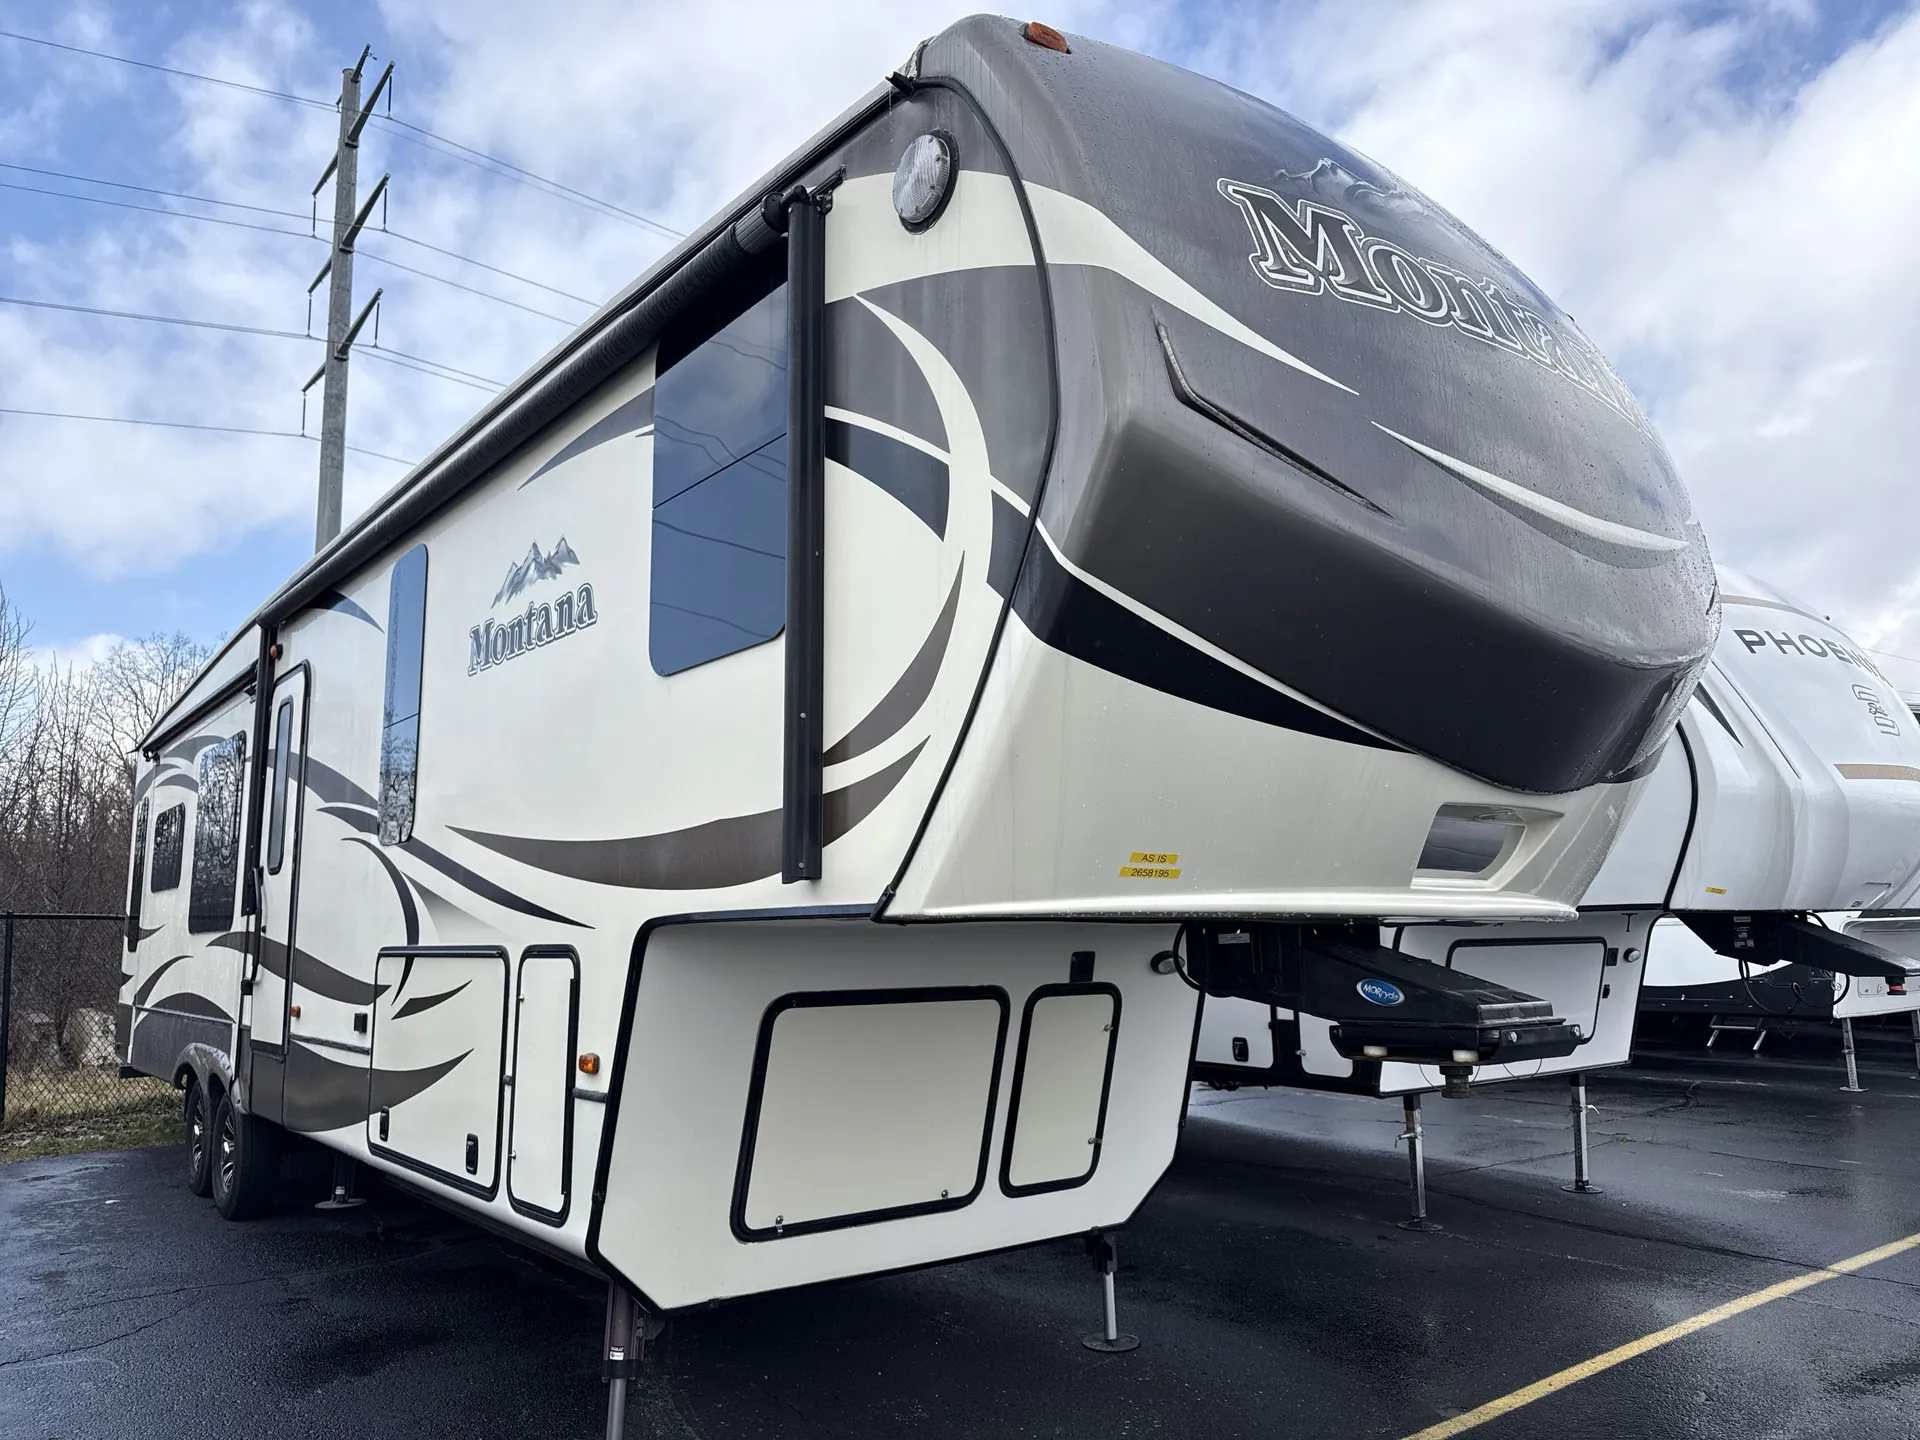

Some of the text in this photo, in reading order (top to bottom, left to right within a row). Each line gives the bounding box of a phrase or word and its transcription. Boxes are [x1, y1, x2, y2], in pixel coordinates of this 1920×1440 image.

[468, 582, 598, 677] Montana
[1141, 854, 1167, 863] AS IS
[1131, 868, 1170, 878] 2658195
